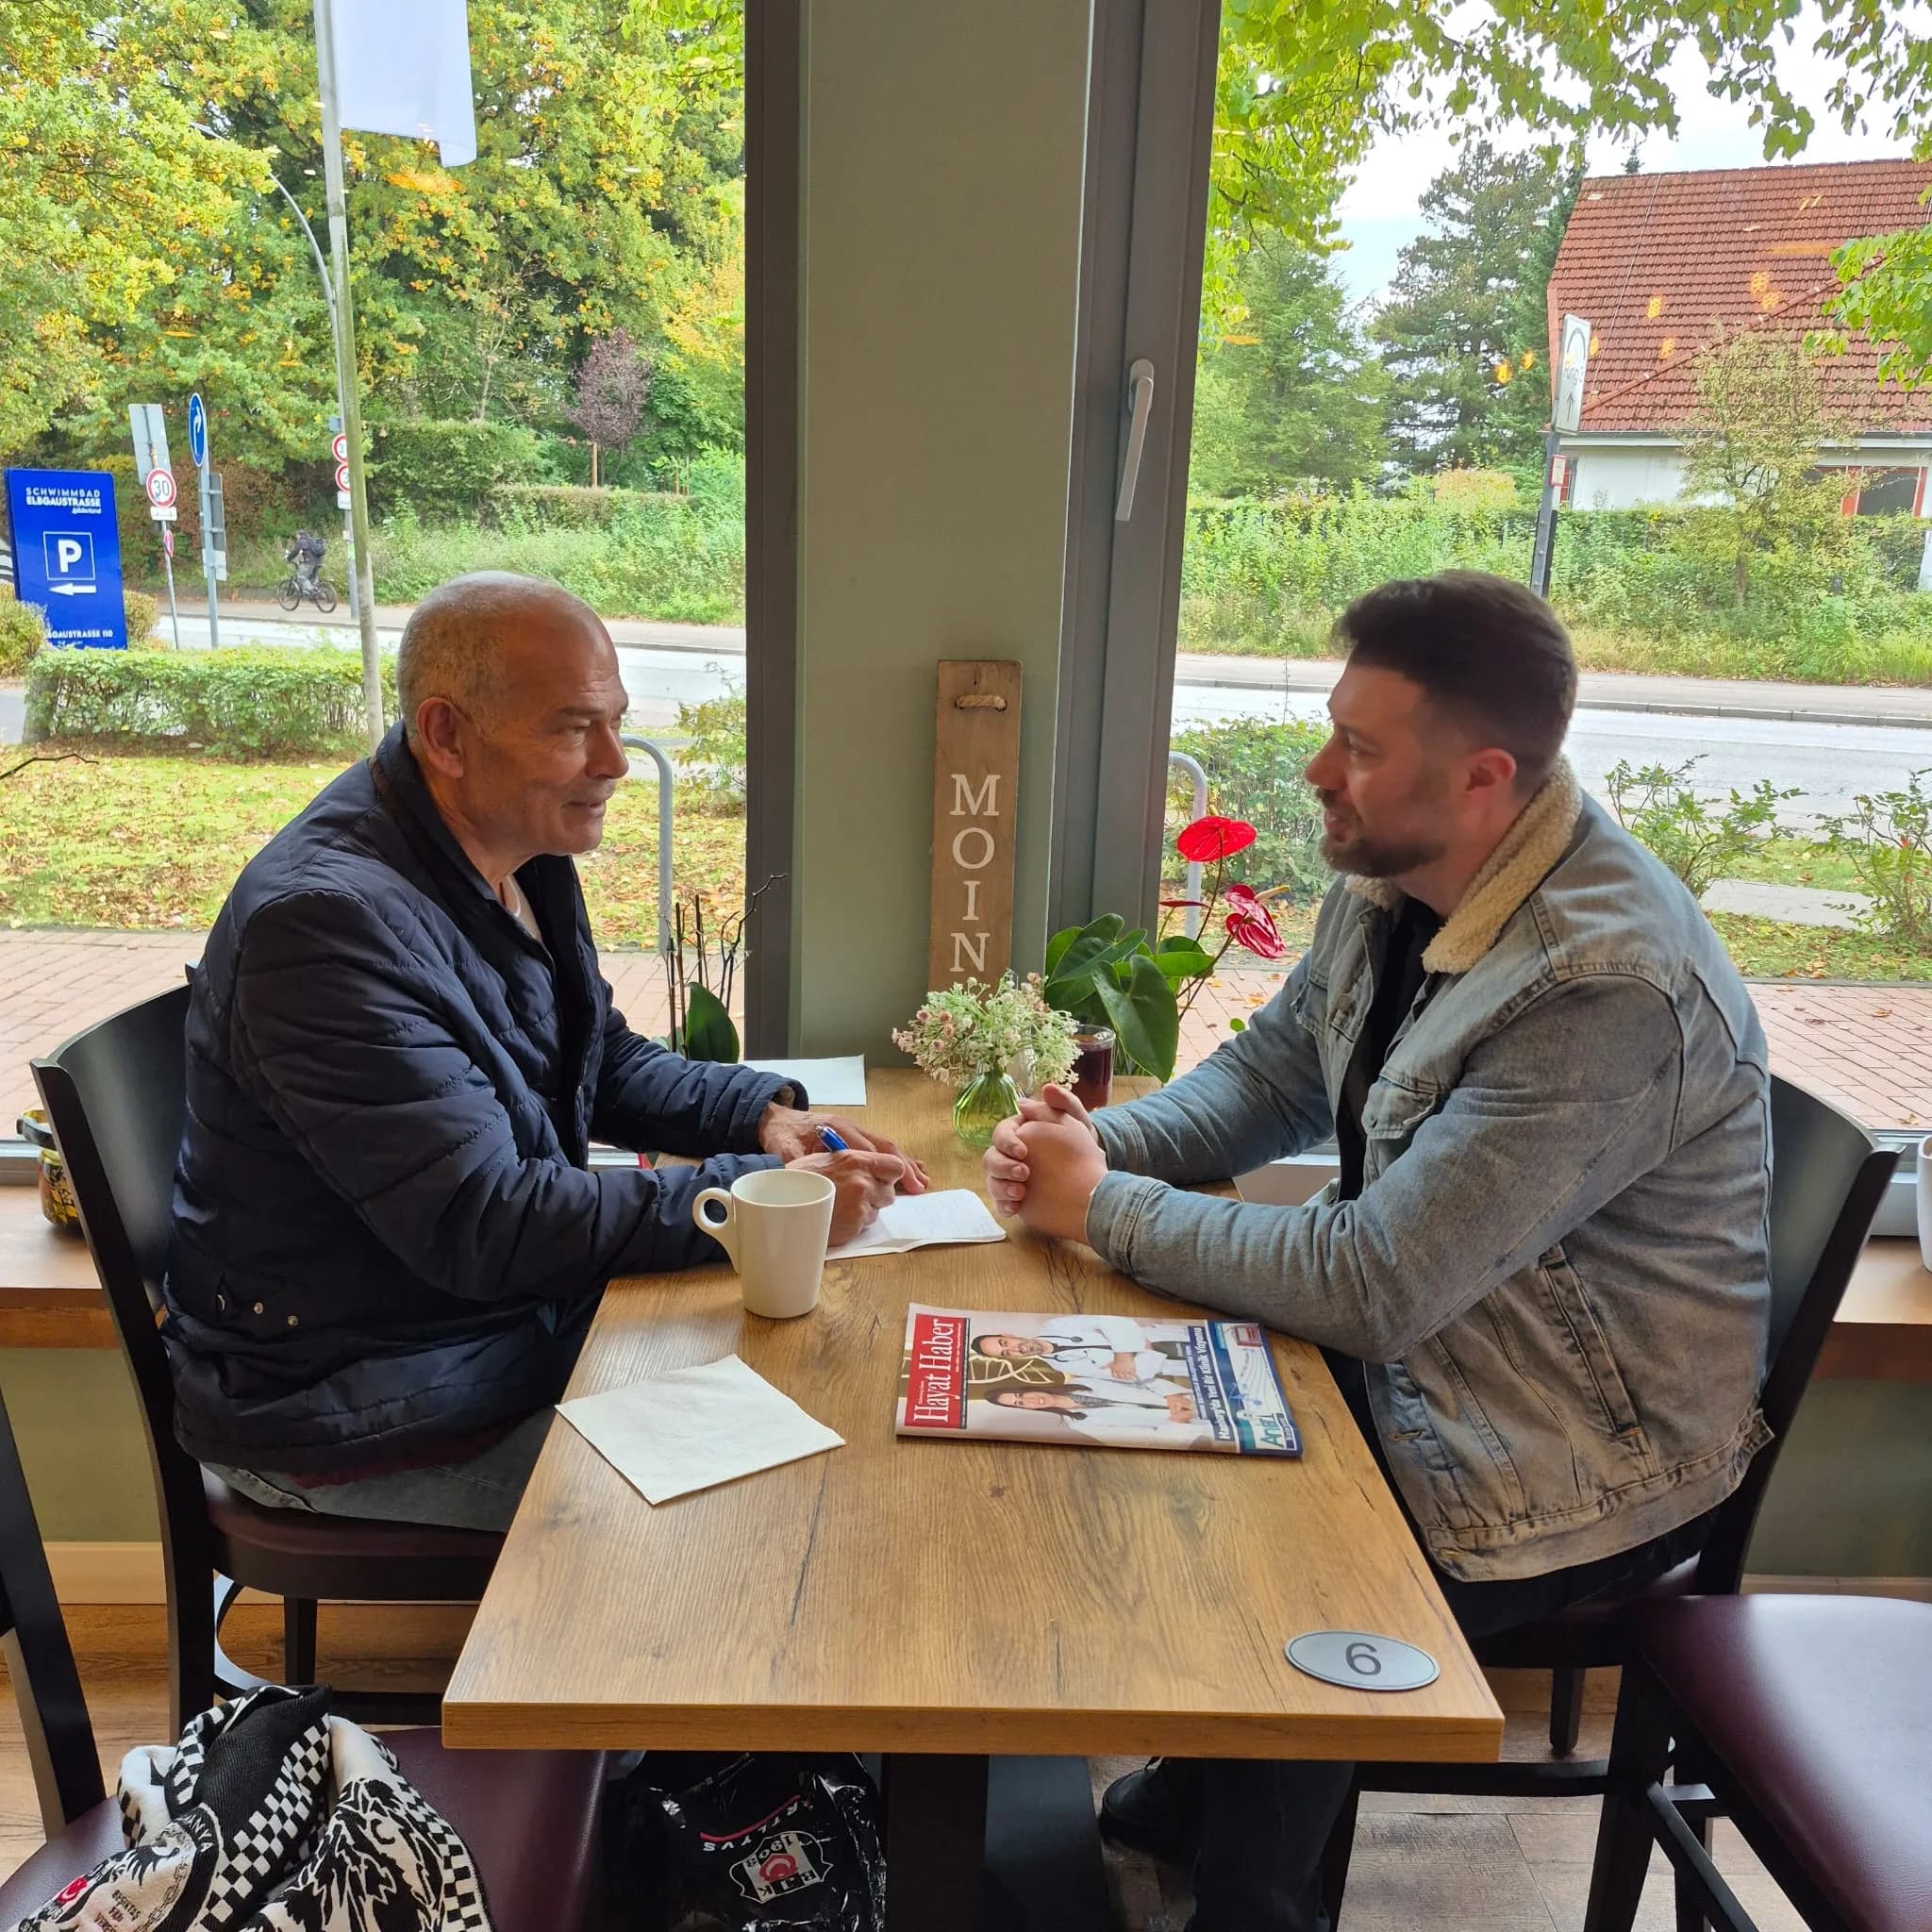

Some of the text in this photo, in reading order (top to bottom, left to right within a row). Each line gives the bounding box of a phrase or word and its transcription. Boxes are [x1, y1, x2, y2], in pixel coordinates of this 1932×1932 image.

[25, 487, 100, 498] SCHWIMMBAD
[153, 479, 170, 497] 30
[26, 495, 101, 508] ELBGAUSTRASSE
[58, 539, 82, 573] P
[948, 774, 1002, 973] MOIN
[913, 1319, 960, 1423] Hayat Haber
[1204, 1384, 1218, 1398] Yeni
[1345, 1642, 1382, 1676] 6
